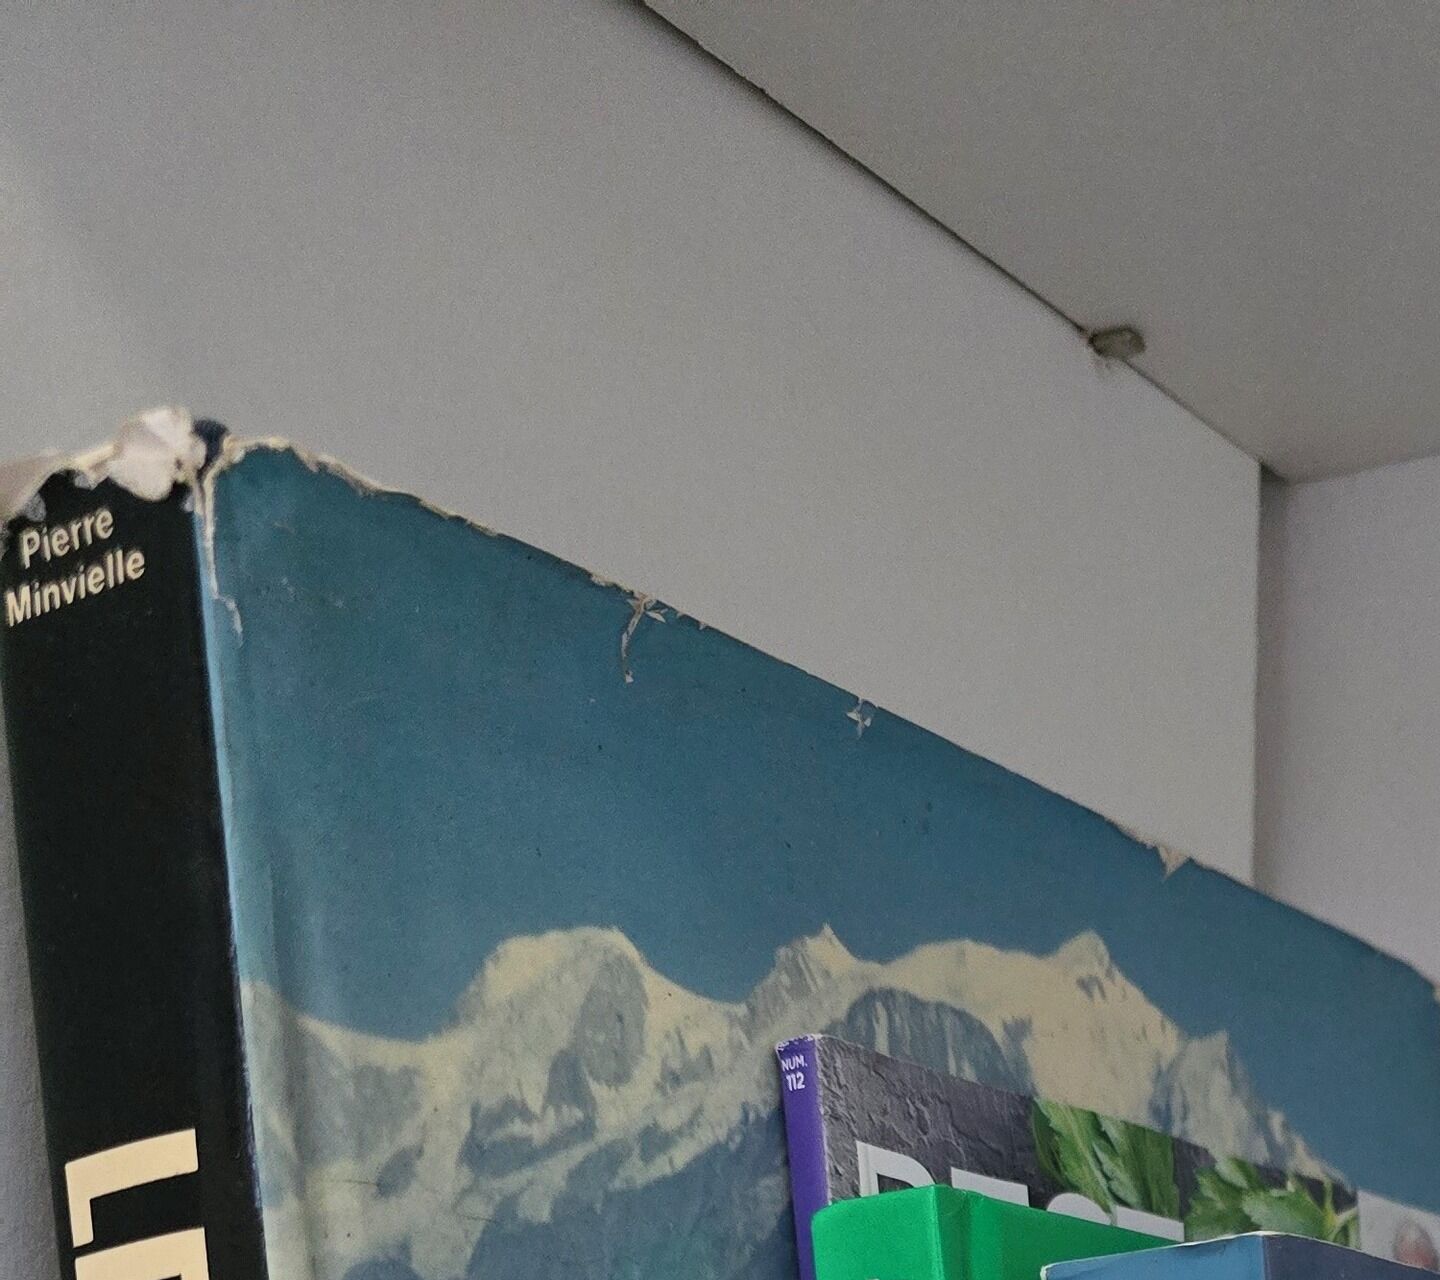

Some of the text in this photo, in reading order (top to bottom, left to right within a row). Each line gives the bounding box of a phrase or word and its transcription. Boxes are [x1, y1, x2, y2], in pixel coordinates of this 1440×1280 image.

[20, 507, 115, 569] Pierre
[4, 548, 146, 627] Minvielle
[781, 1054, 808, 1072] NUM.
[785, 1071, 806, 1092] 112
